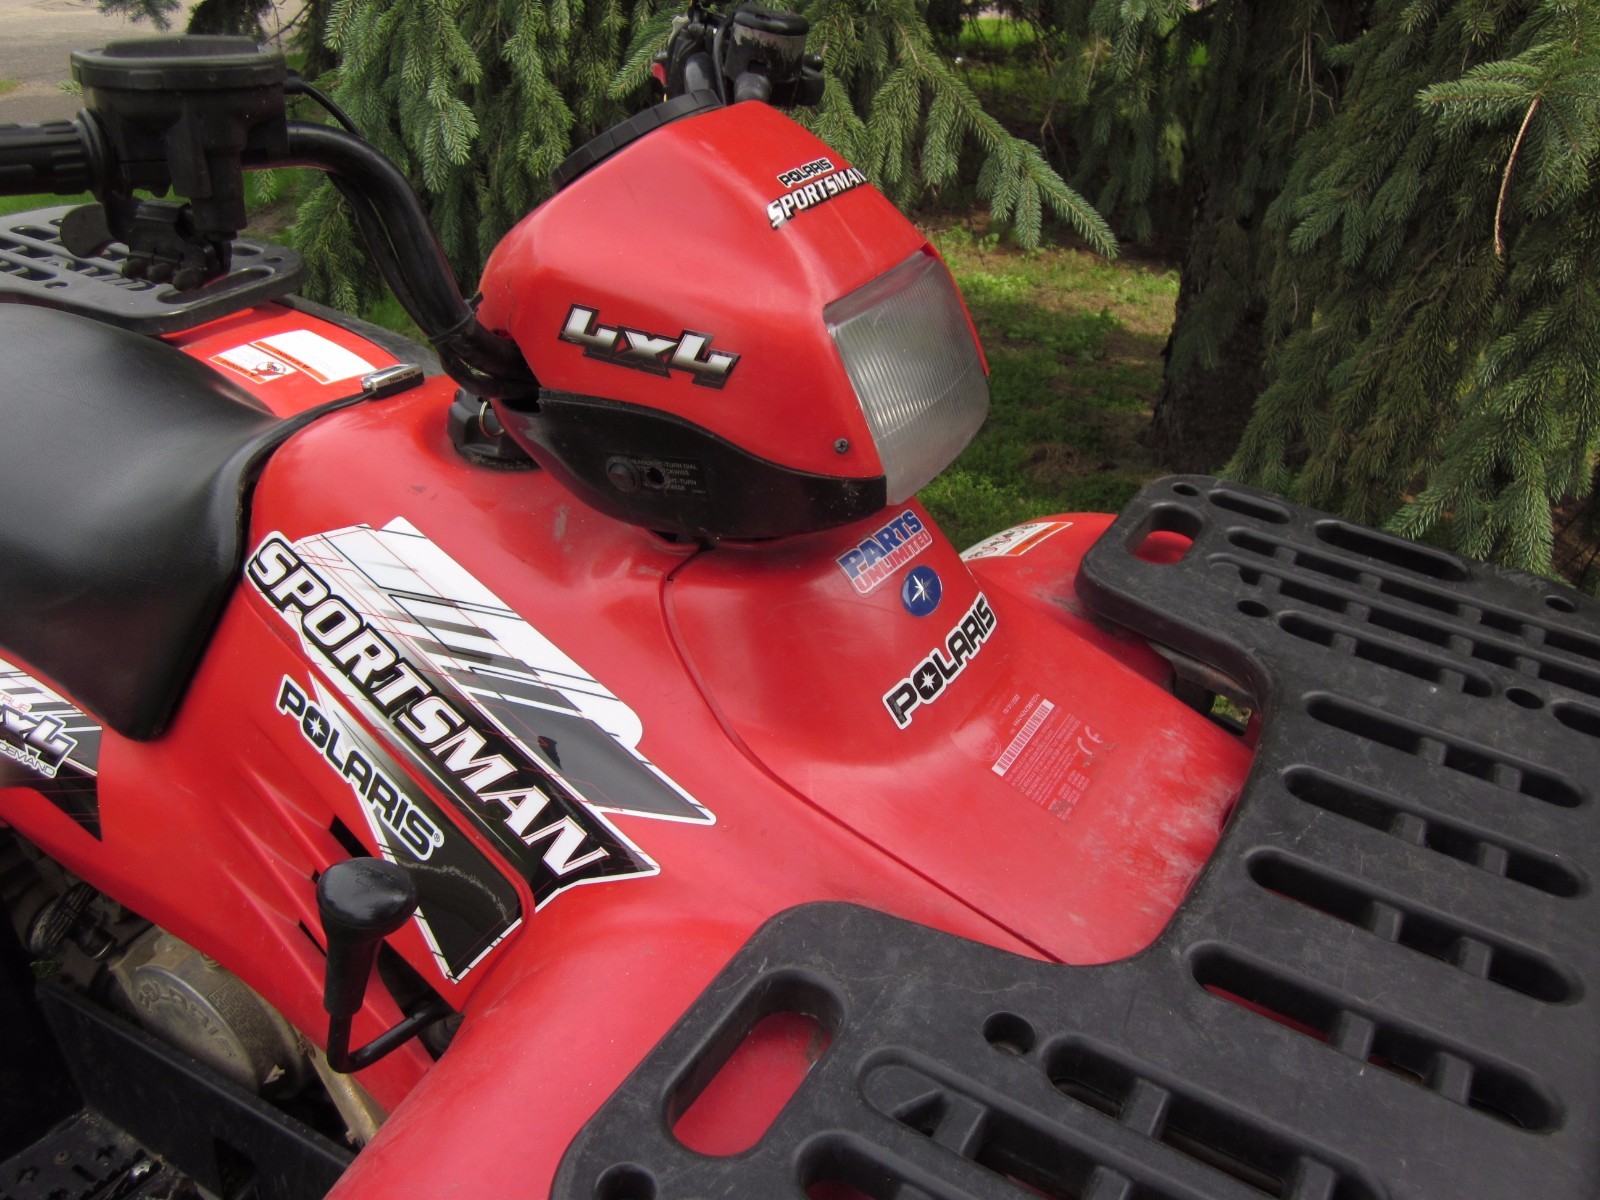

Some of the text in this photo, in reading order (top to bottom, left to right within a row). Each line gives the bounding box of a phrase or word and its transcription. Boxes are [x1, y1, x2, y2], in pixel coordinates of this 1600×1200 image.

[767, 167, 868, 229] SPORTSMAN
[778, 158, 833, 187] POLARIS
[838, 510, 923, 579] PARTS
[853, 528, 932, 592] UNLIMITED
[884, 595, 996, 727] POLARIS
[250, 539, 610, 877] SPORTSMAN
